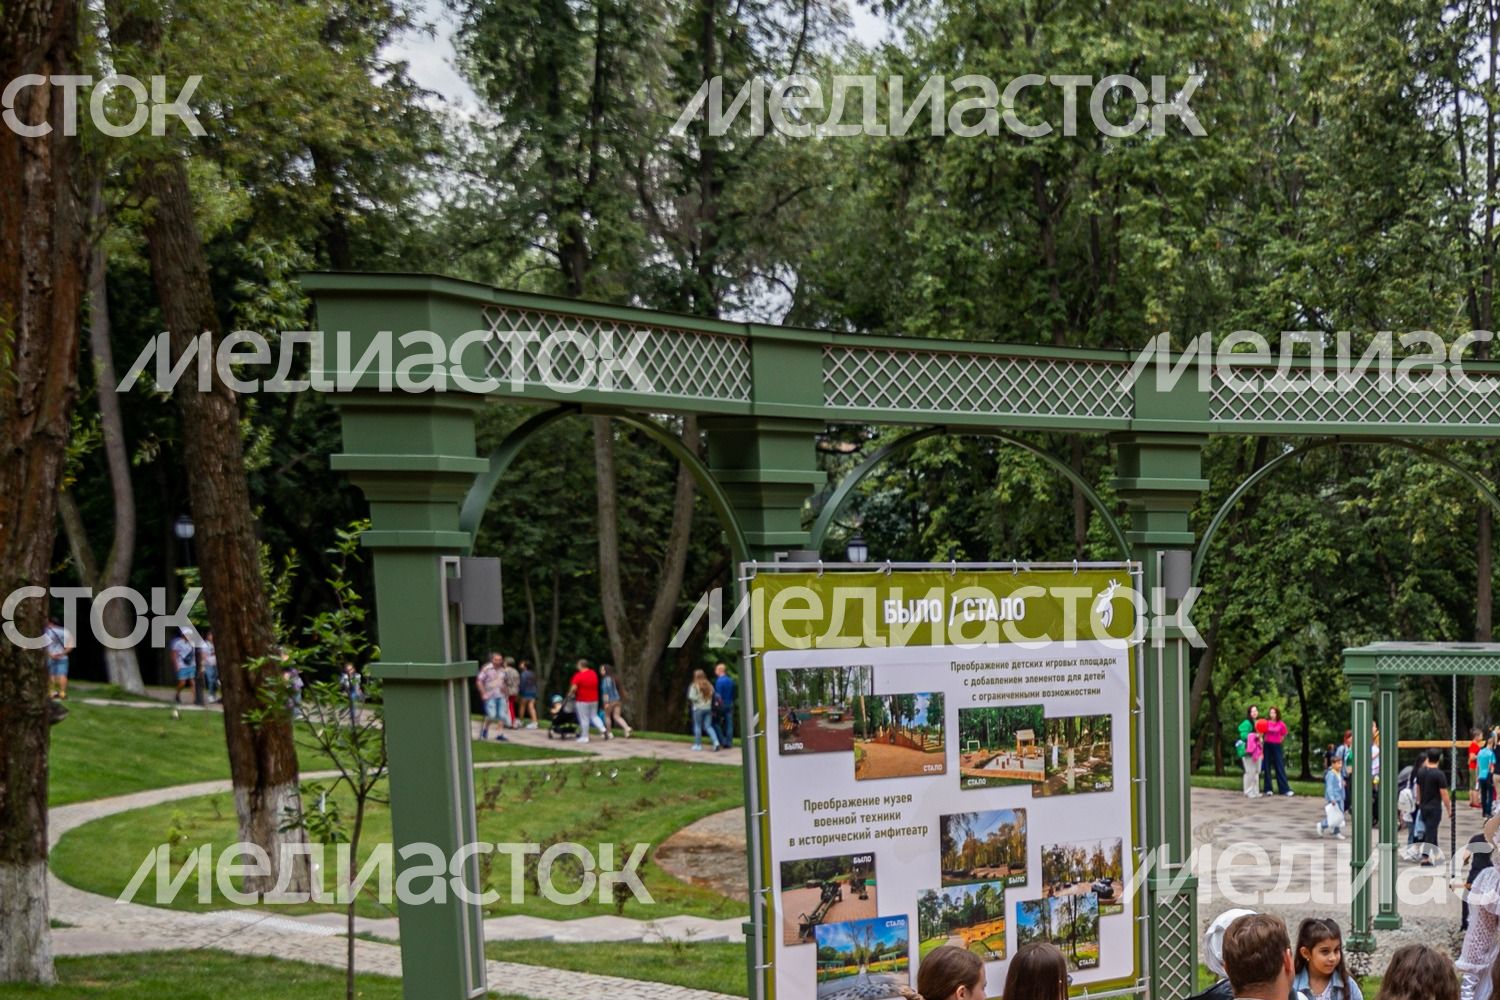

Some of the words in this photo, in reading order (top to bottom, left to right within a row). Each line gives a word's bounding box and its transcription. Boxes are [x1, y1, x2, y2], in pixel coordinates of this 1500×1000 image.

[883, 599, 943, 624] БЫЛО
[962, 597, 1026, 622] СТАЛО
[950, 660, 1009, 673] Преображение
[1011, 660, 1043, 671] детских
[1045, 659, 1077, 670] игровых
[1079, 657, 1117, 668] площадок
[970, 675, 1023, 688] добавлением
[1025, 674, 1066, 685] элементов
[1067, 674, 1082, 684] для
[1083, 670, 1106, 683] детей
[978, 690, 1040, 702] ограниченными
[1042, 687, 1101, 698] возможностями
[804, 796, 880, 814] Преображение
[883, 794, 913, 807] музея
[814, 812, 857, 828] военной
[860, 811, 902, 823] техники
[789, 837, 795, 847] в
[798, 827, 872, 846] исторический
[874, 825, 928, 841] амфитеатр
